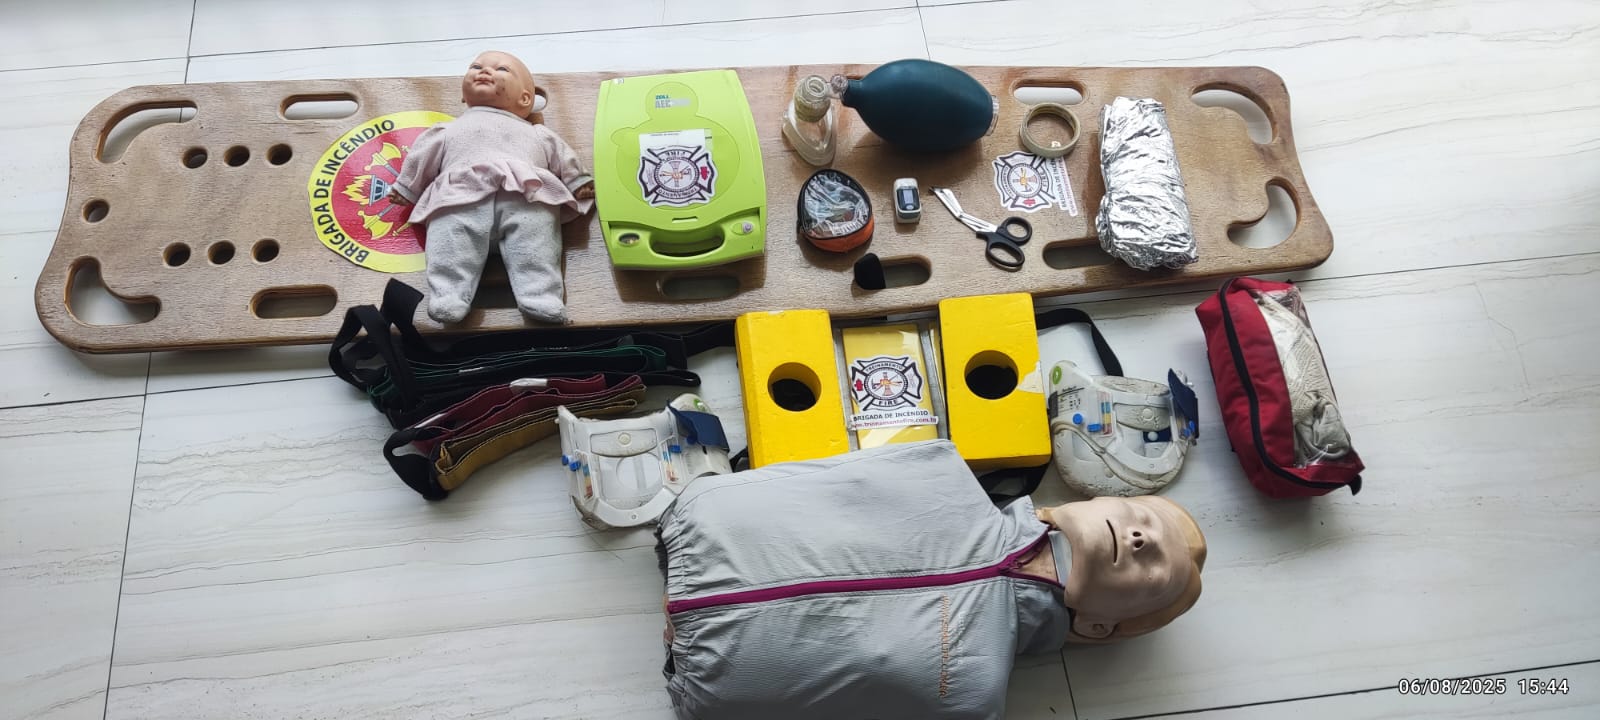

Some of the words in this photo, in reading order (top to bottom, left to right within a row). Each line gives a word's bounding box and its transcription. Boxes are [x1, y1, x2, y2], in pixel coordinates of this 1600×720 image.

[324, 119, 395, 176] INCÊNDIO
[313, 178, 331, 200] DE
[314, 203, 370, 263] BRIGADA
[853, 414, 883, 422] BRIGADA
